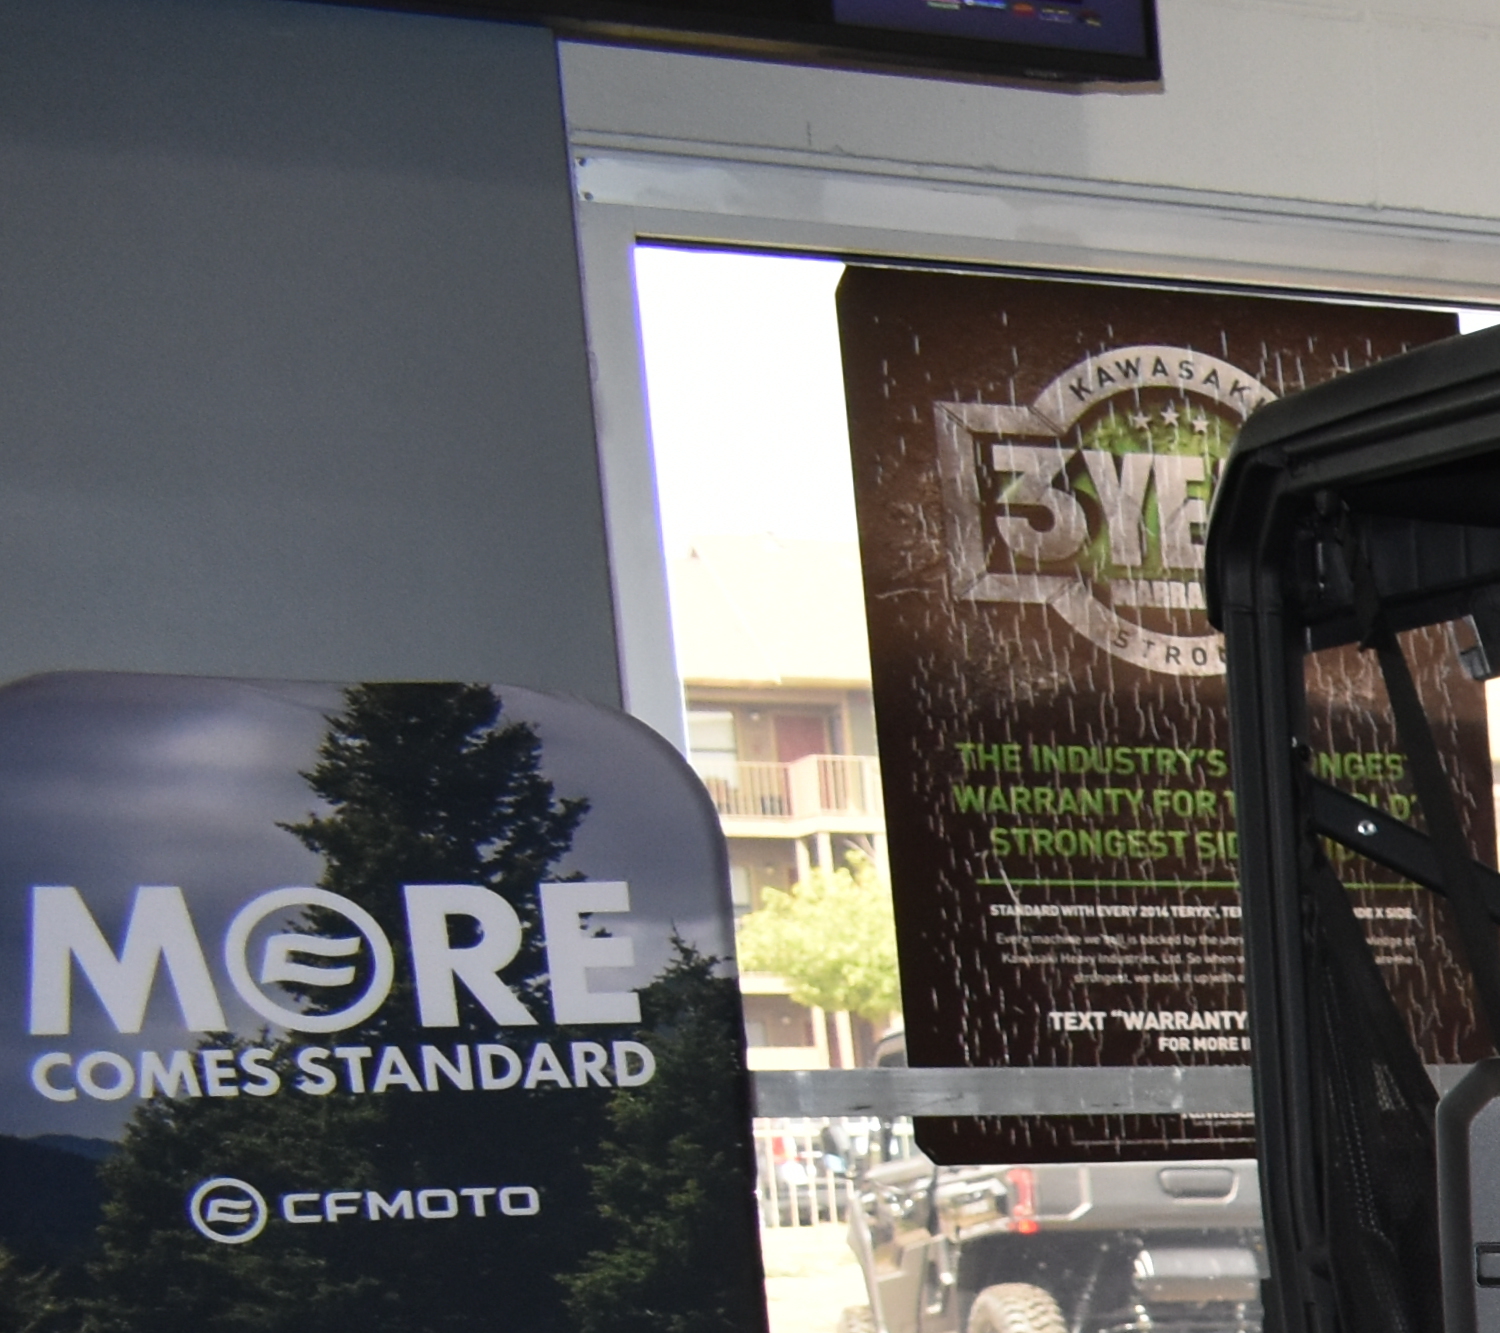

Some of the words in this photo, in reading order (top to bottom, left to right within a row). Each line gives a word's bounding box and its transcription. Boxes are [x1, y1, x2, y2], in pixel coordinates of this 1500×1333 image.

[992, 444, 1088, 562] 3
[1113, 630, 1227, 667] STRO
[955, 743, 1022, 774] THE
[1033, 744, 1228, 778] INDUSTRY'S
[953, 785, 1145, 817] WARRANTY
[1153, 788, 1216, 818] FOR
[990, 827, 1188, 859] STRONGEST
[990, 904, 1060, 917] STANDARD
[1060, 904, 1095, 917] WITH
[1096, 904, 1138, 918] EVERY
[1049, 1011, 1107, 1031] TEXT
[1158, 1036, 1191, 1051] FOR
[1193, 1036, 1239, 1051] MORE
[31, 1045, 281, 1102] COMES
[297, 1040, 656, 1096] STANDARD
[282, 1185, 541, 1225] CFMOTO
